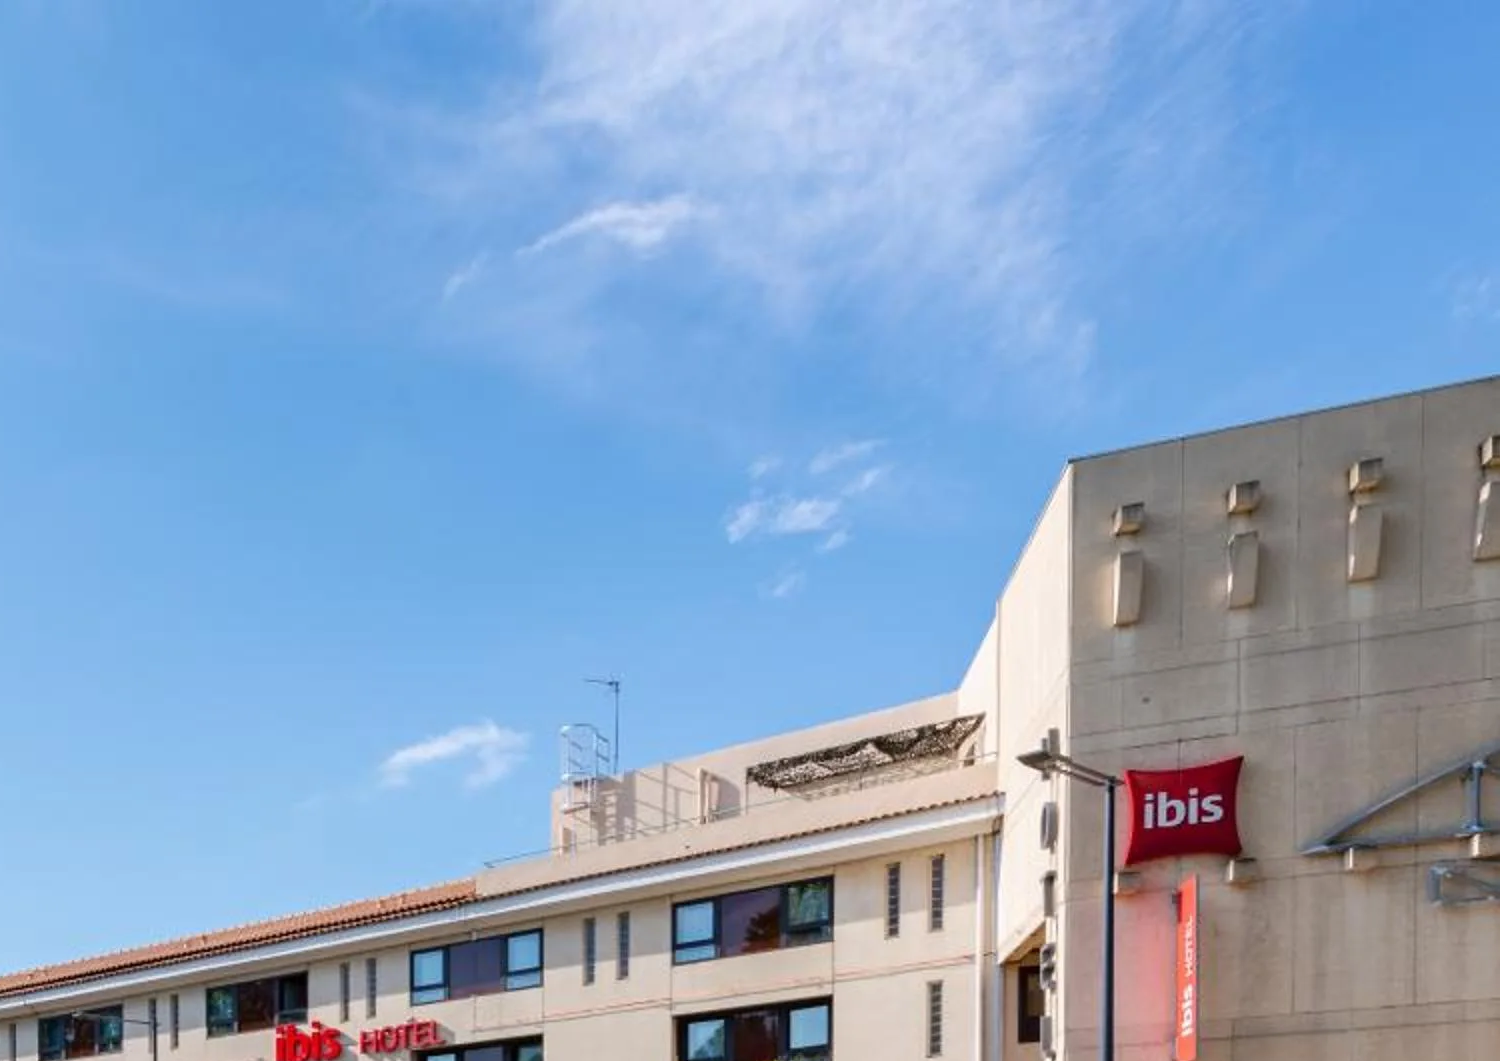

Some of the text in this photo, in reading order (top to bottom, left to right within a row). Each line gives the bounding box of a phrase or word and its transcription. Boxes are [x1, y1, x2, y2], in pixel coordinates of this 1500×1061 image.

[1143, 787, 1224, 829] ibis
[1181, 983, 1194, 1037] ibis
[359, 1020, 447, 1055] HOTEL
